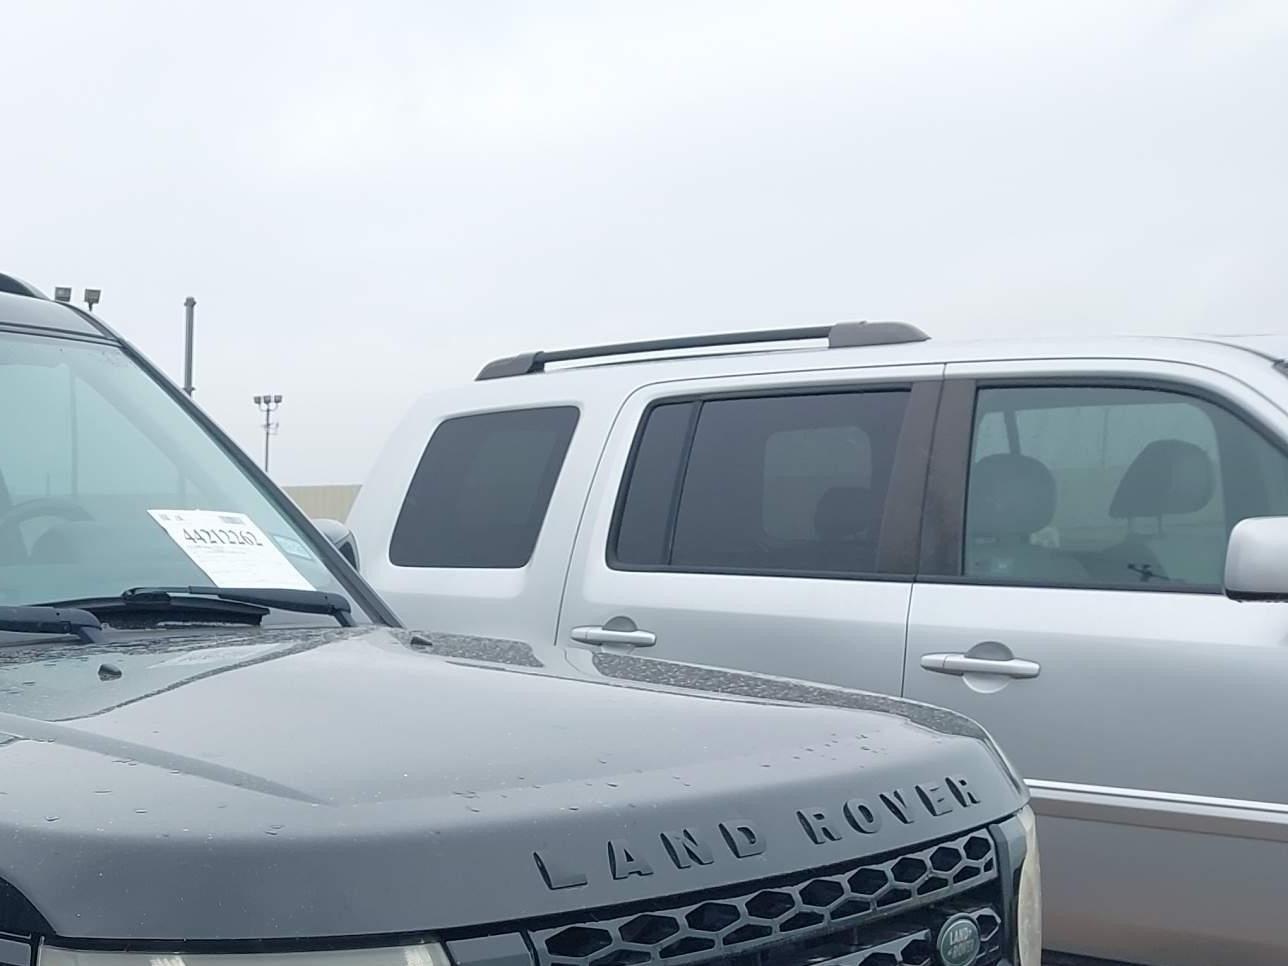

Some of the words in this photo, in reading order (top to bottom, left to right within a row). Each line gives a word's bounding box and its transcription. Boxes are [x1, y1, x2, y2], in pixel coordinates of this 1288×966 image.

[183, 528, 264, 546] 44212262
[532, 818, 767, 891] LAND
[796, 775, 981, 845] ROVER
[949, 927, 969, 946] LAND
